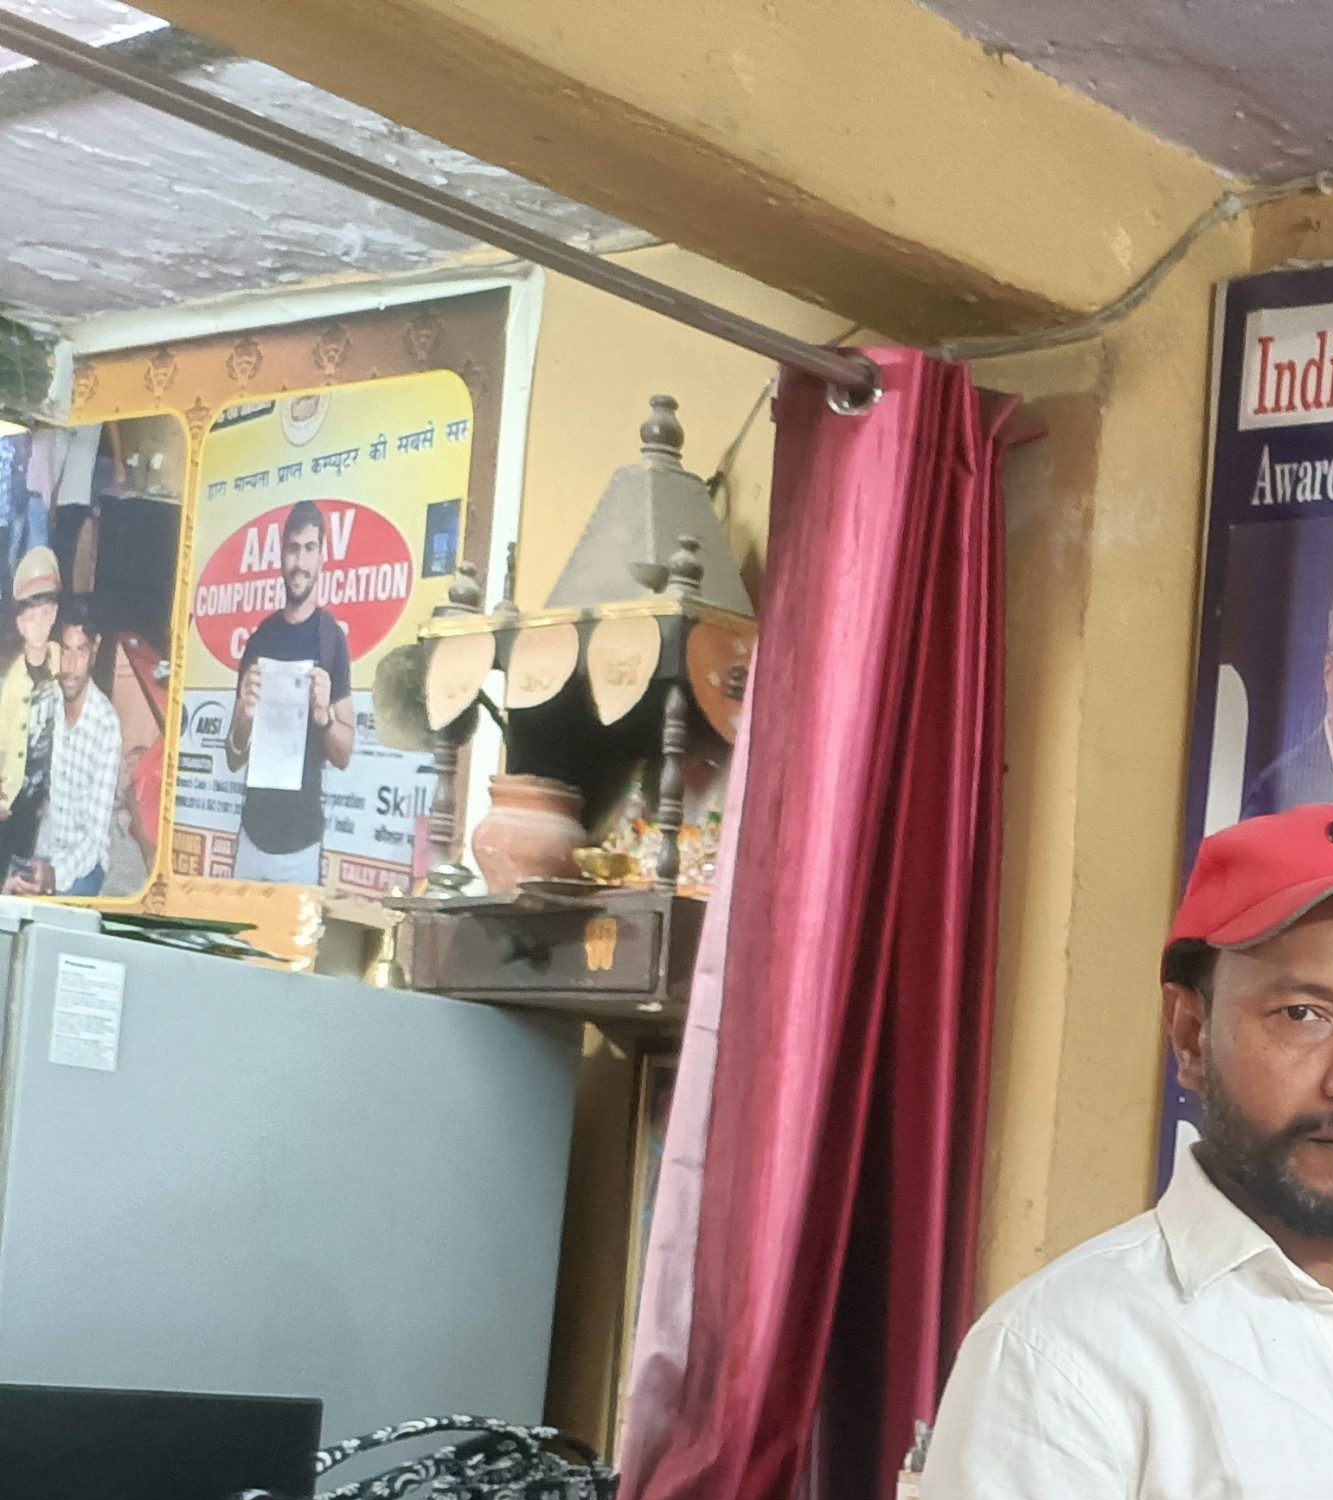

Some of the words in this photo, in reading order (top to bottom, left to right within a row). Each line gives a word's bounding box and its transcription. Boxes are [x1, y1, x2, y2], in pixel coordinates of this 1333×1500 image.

[370, 434, 387, 460] की
[398, 421, 434, 453] सबसे
[240, 509, 355, 574] AAV
[317, 562, 410, 607] UCATION
